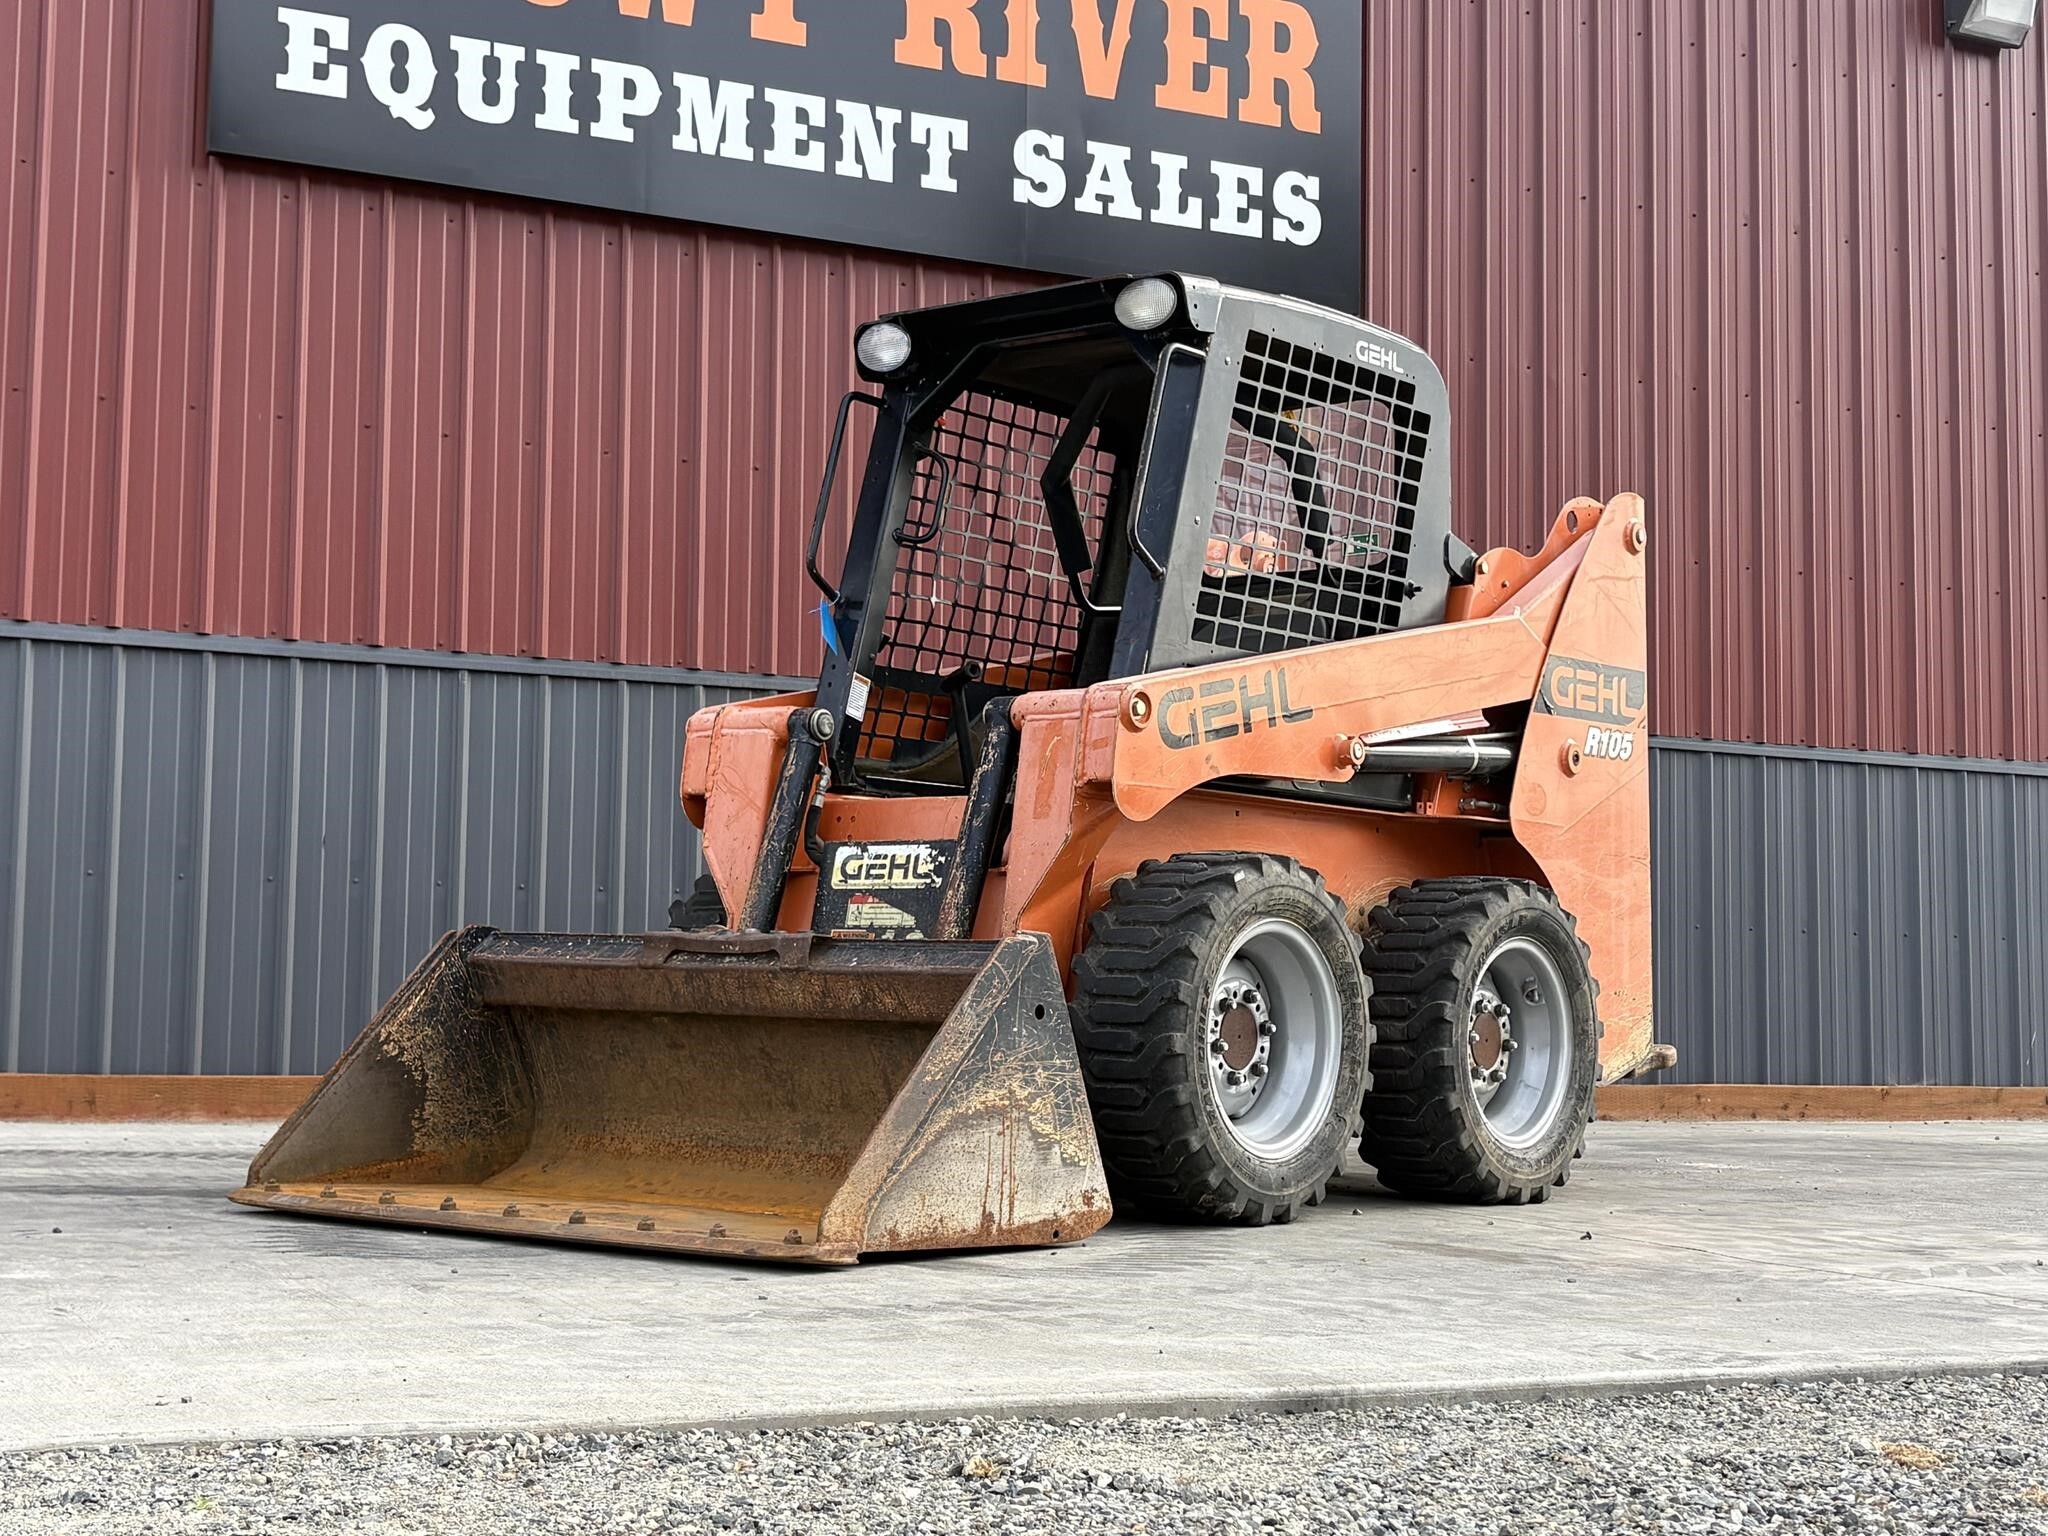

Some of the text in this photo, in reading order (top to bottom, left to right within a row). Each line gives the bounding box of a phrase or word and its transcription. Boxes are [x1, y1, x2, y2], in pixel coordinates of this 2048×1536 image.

[276, 6, 1323, 247] EQUIPMENT SALES
[1355, 340, 1404, 374] GEHL
[1157, 667, 1313, 750] GEHL
[1550, 665, 1641, 719] GEHL
[1583, 725, 1635, 761] R105
[840, 853, 932, 880] GEHL
